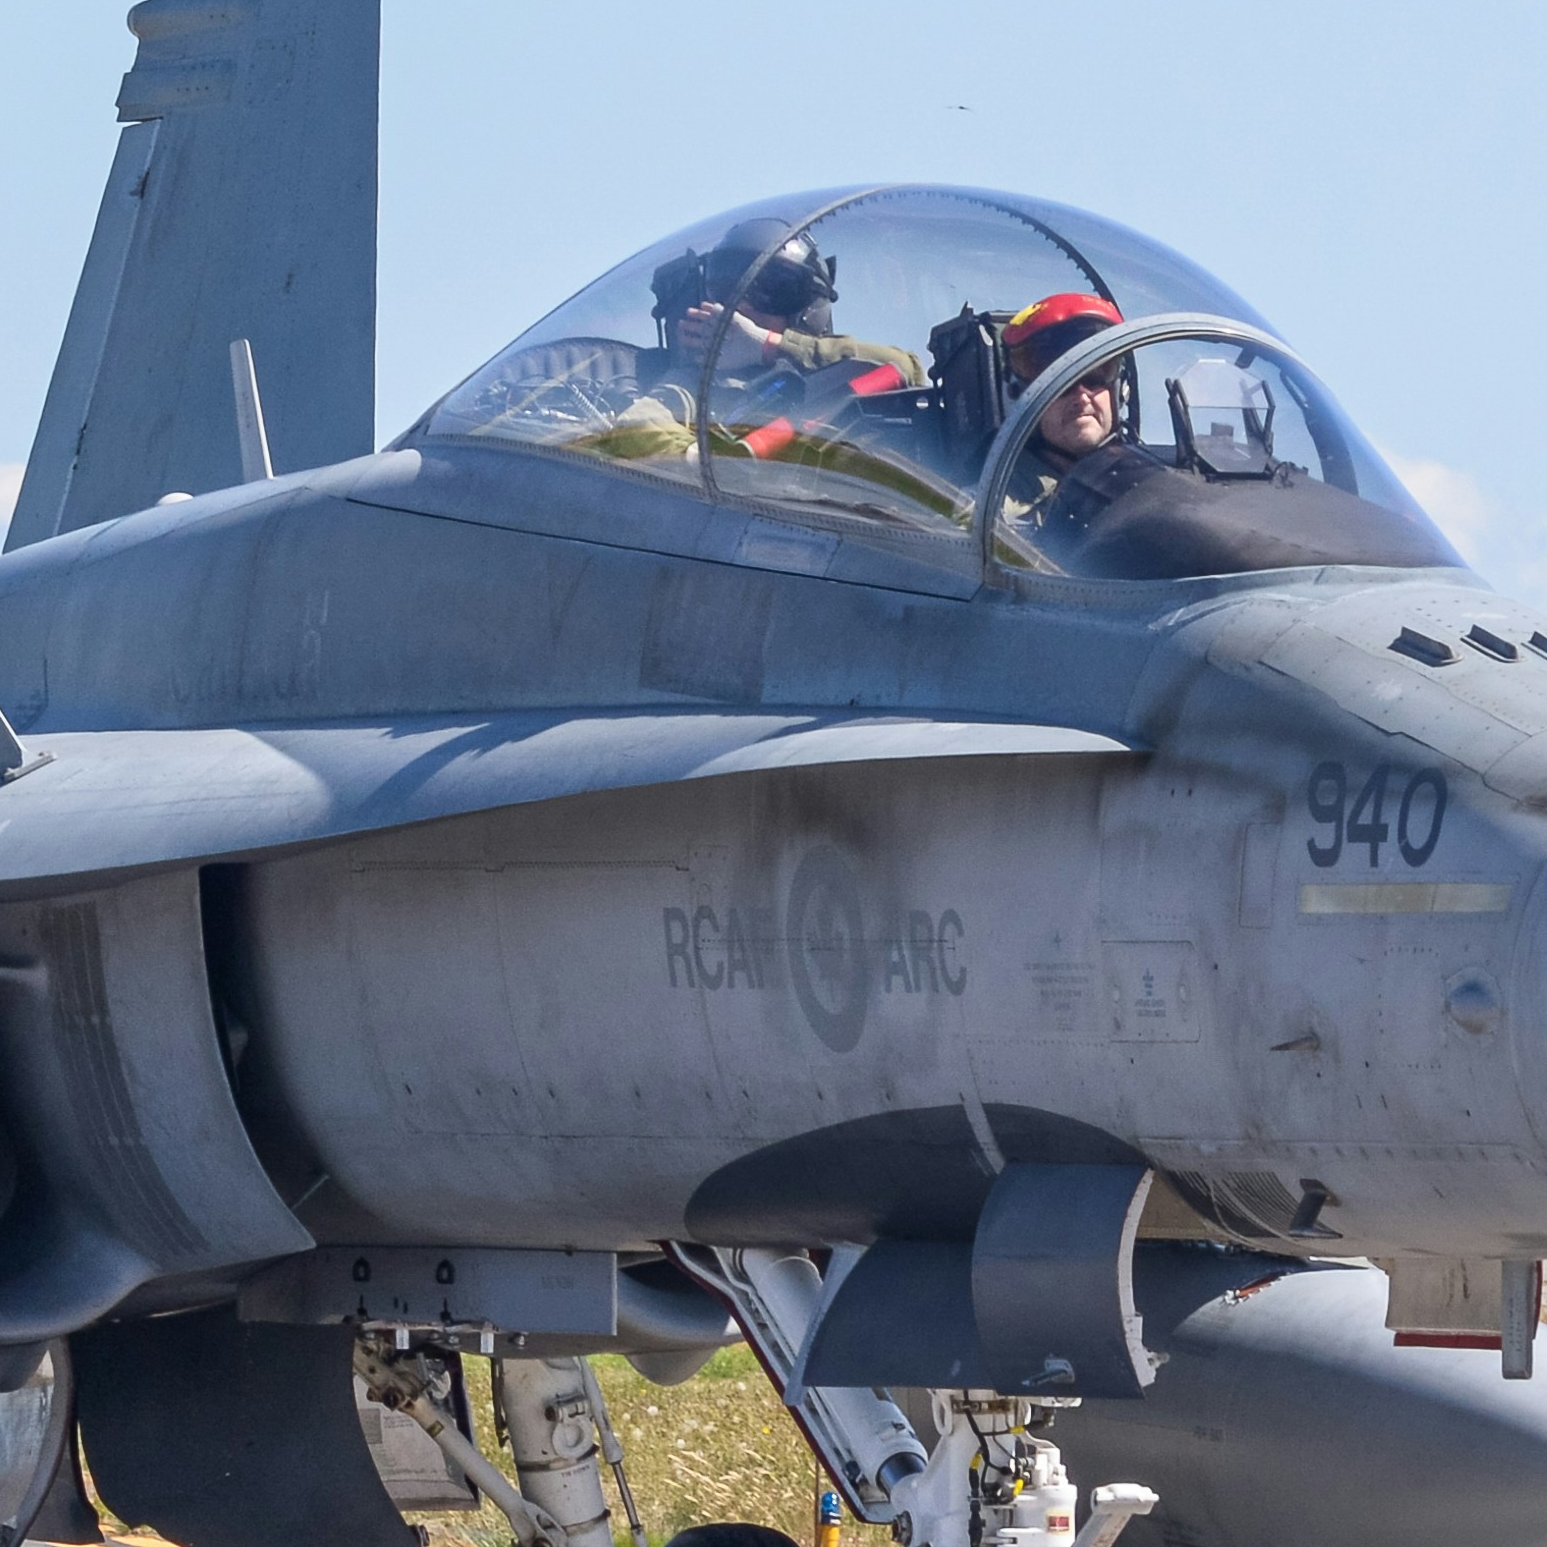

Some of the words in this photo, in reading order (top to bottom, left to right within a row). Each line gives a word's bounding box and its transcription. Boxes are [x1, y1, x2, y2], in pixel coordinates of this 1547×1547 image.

[1306, 760, 1448, 868] 940
[662, 905, 776, 991] RCAF
[882, 908, 968, 996] ARC
